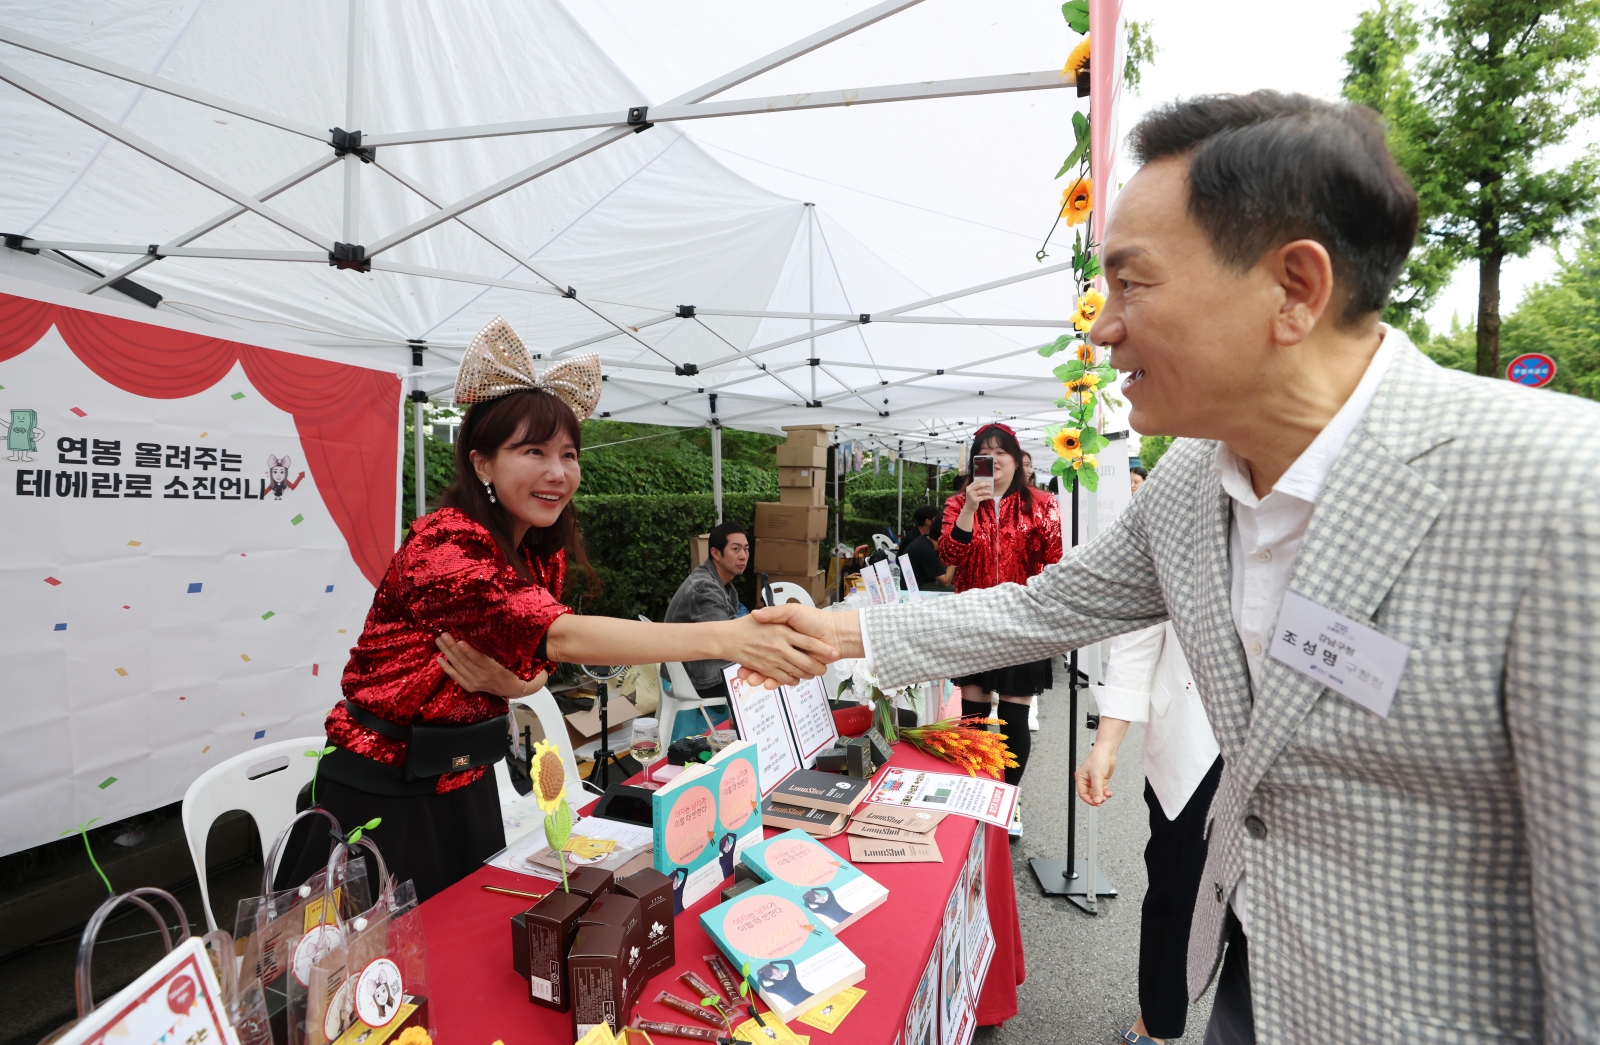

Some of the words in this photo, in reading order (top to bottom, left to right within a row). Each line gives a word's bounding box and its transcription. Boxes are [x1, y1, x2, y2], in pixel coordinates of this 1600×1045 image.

[56, 437, 121, 467] 연봉
[135, 442, 242, 472] 올려주는
[16, 469, 152, 498] 테헤란로
[164, 475, 266, 500] 소진언니
[1318, 632, 1355, 657] 강남구청
[674, 806, 690, 818] 여자는
[691, 797, 707, 810] 남자가
[692, 806, 707, 819] 반한다
[733, 912, 755, 925] 여자는
[754, 901, 777, 915] 남자가
[753, 917, 763, 925] 때
[761, 907, 783, 921] 반한다
[681, 1027, 711, 1037] 1770
